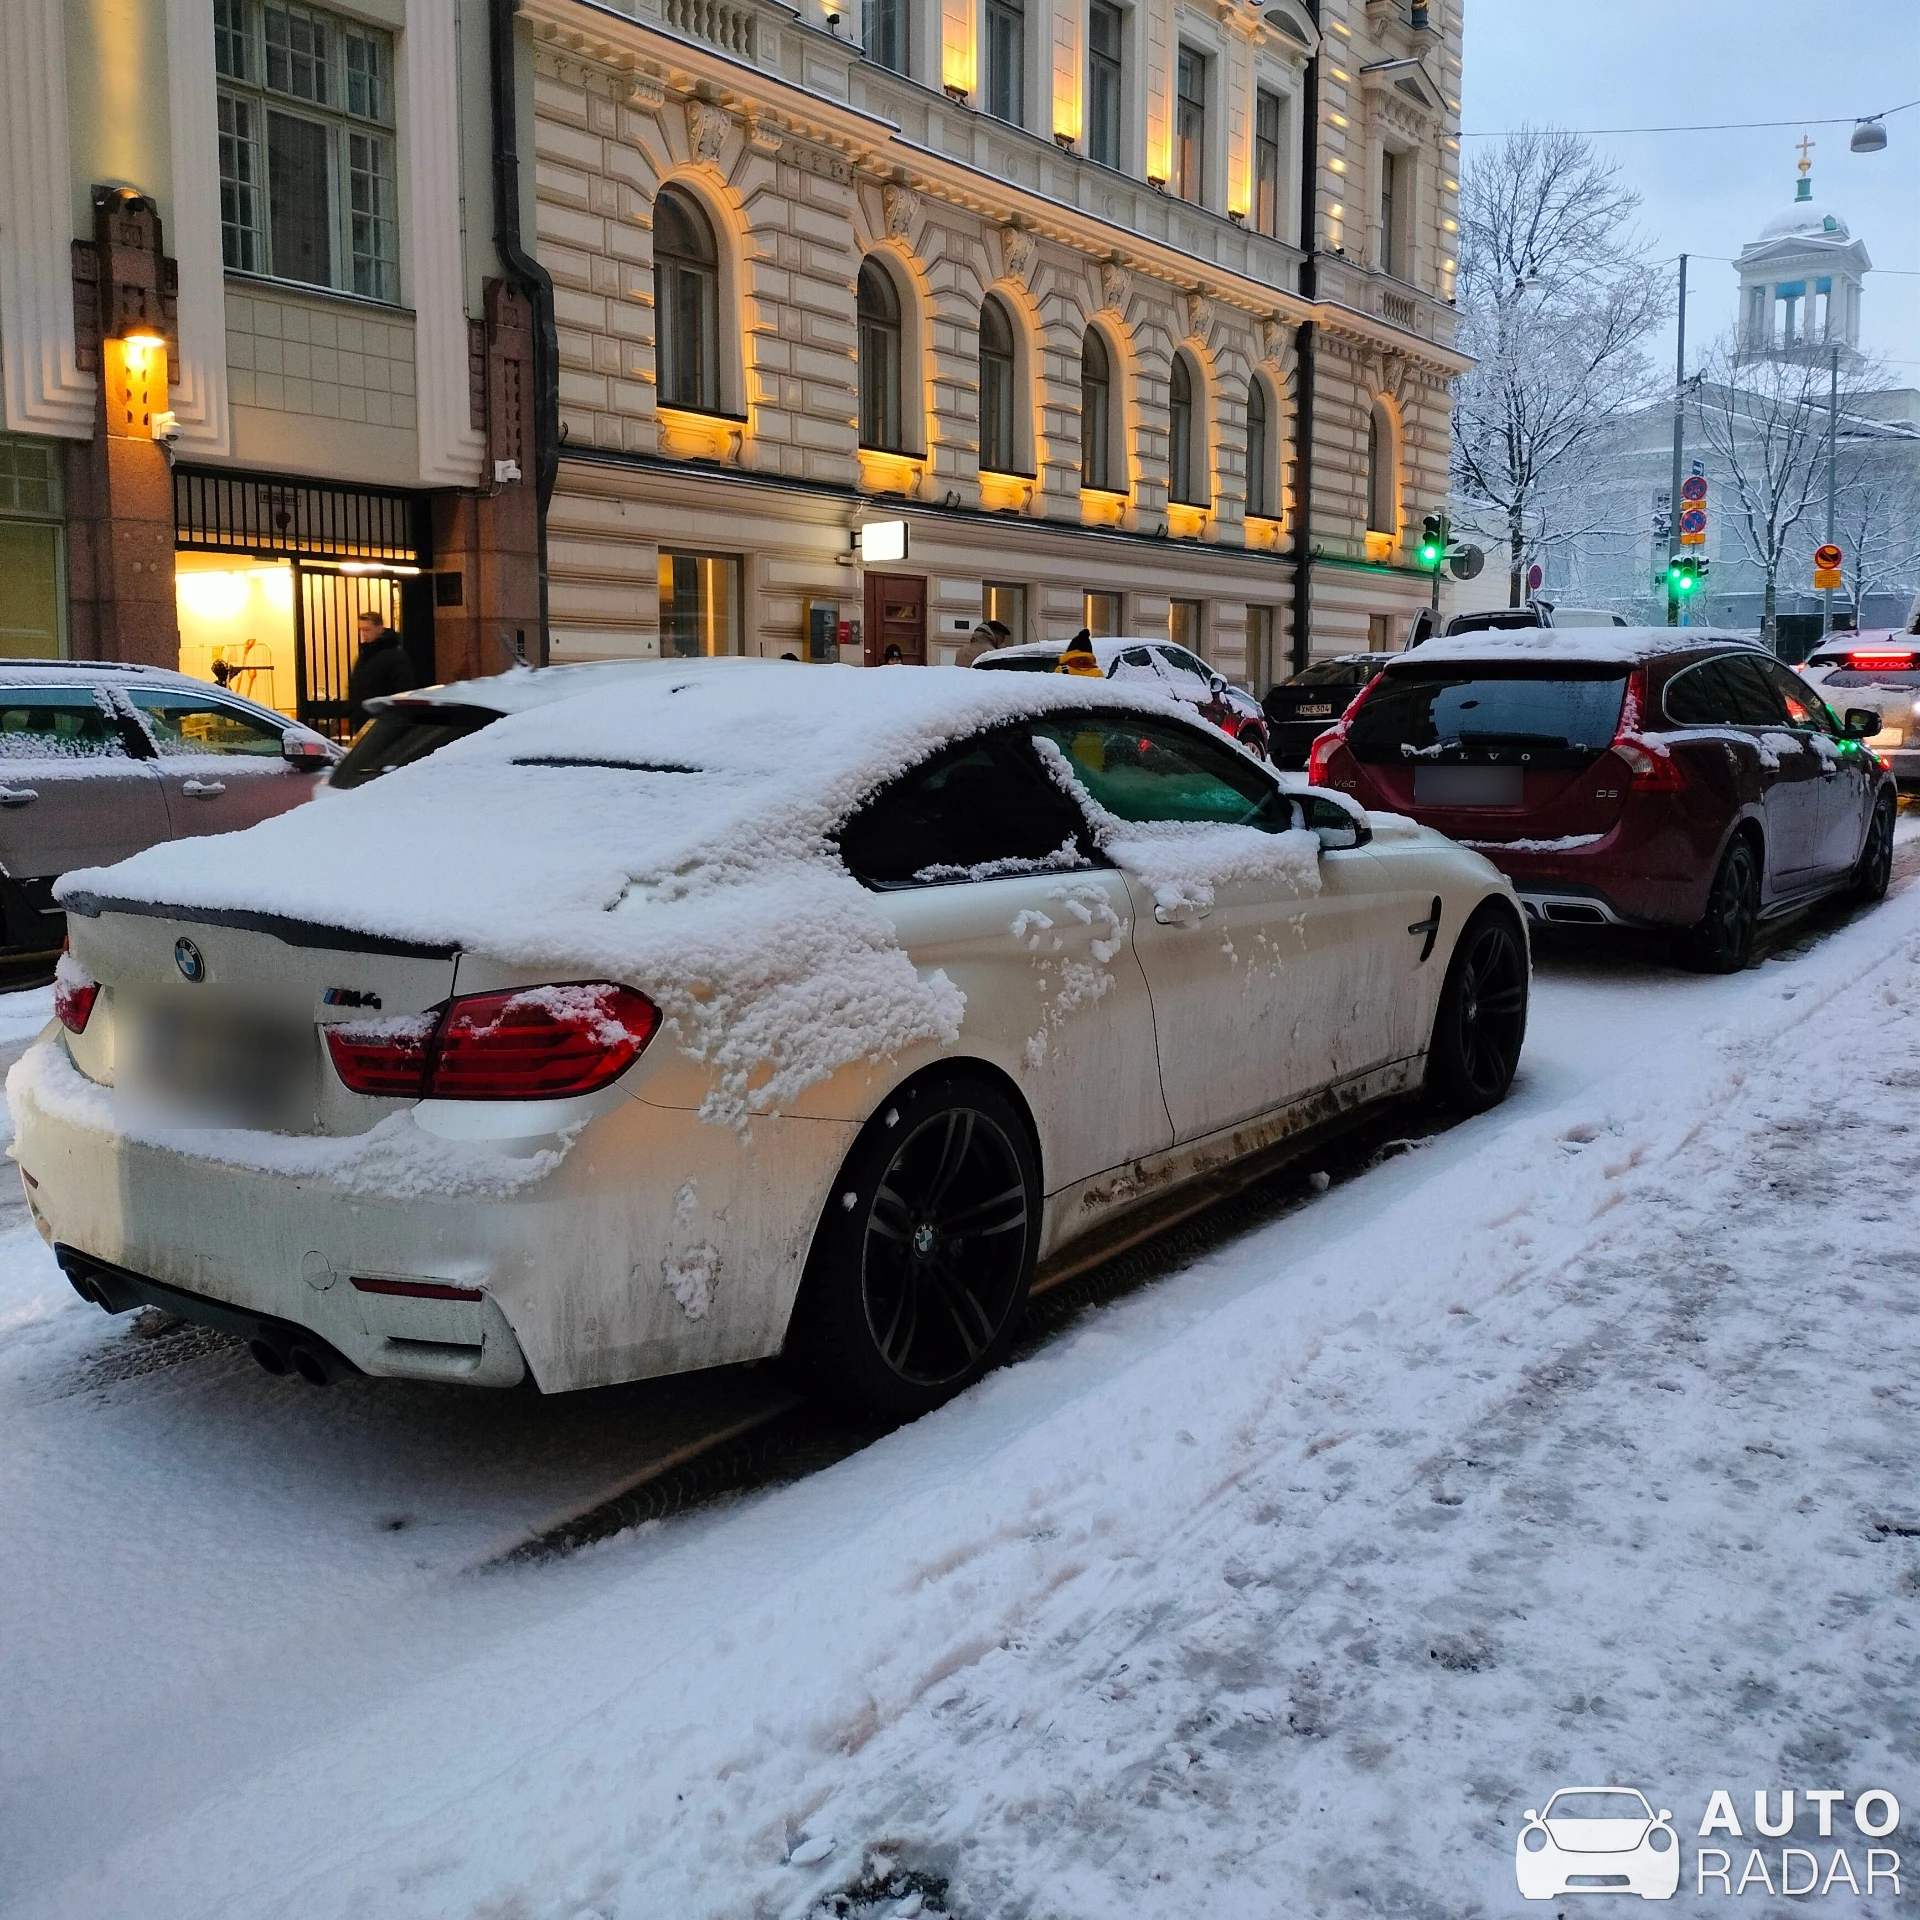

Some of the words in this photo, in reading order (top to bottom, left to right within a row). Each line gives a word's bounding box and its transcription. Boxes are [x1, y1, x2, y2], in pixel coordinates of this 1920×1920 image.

[1301, 705, 1330, 713] XNE-304
[1401, 750, 1531, 760] VOLVO
[1334, 779, 1356, 788] V60
[1595, 789, 1618, 798] D5
[338, 989, 382, 1010] M4
